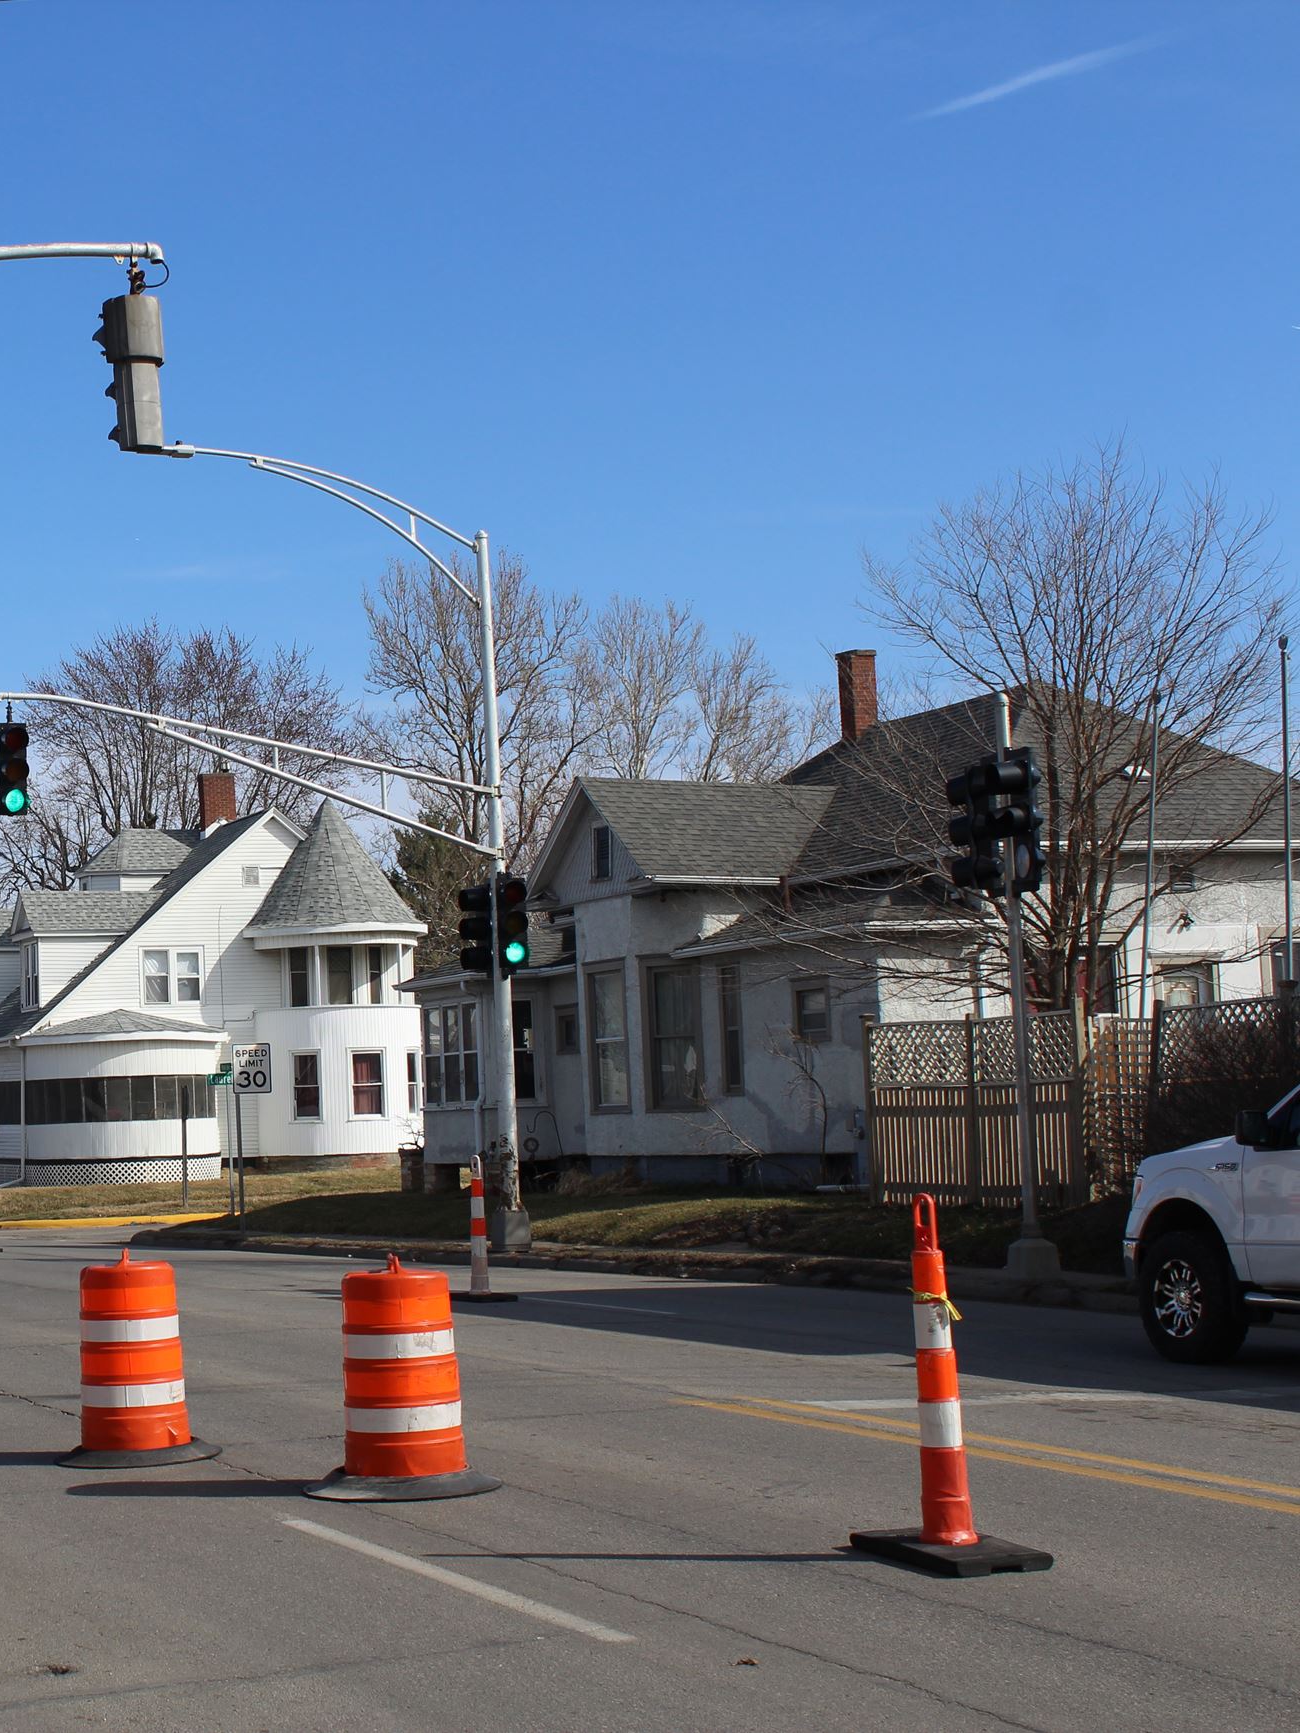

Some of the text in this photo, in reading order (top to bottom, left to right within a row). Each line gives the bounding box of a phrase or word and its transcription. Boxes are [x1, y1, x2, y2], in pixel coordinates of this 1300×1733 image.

[235, 1049, 268, 1058] SPEED
[239, 1059, 264, 1068] LIMIT
[236, 1070, 267, 1089] 30
